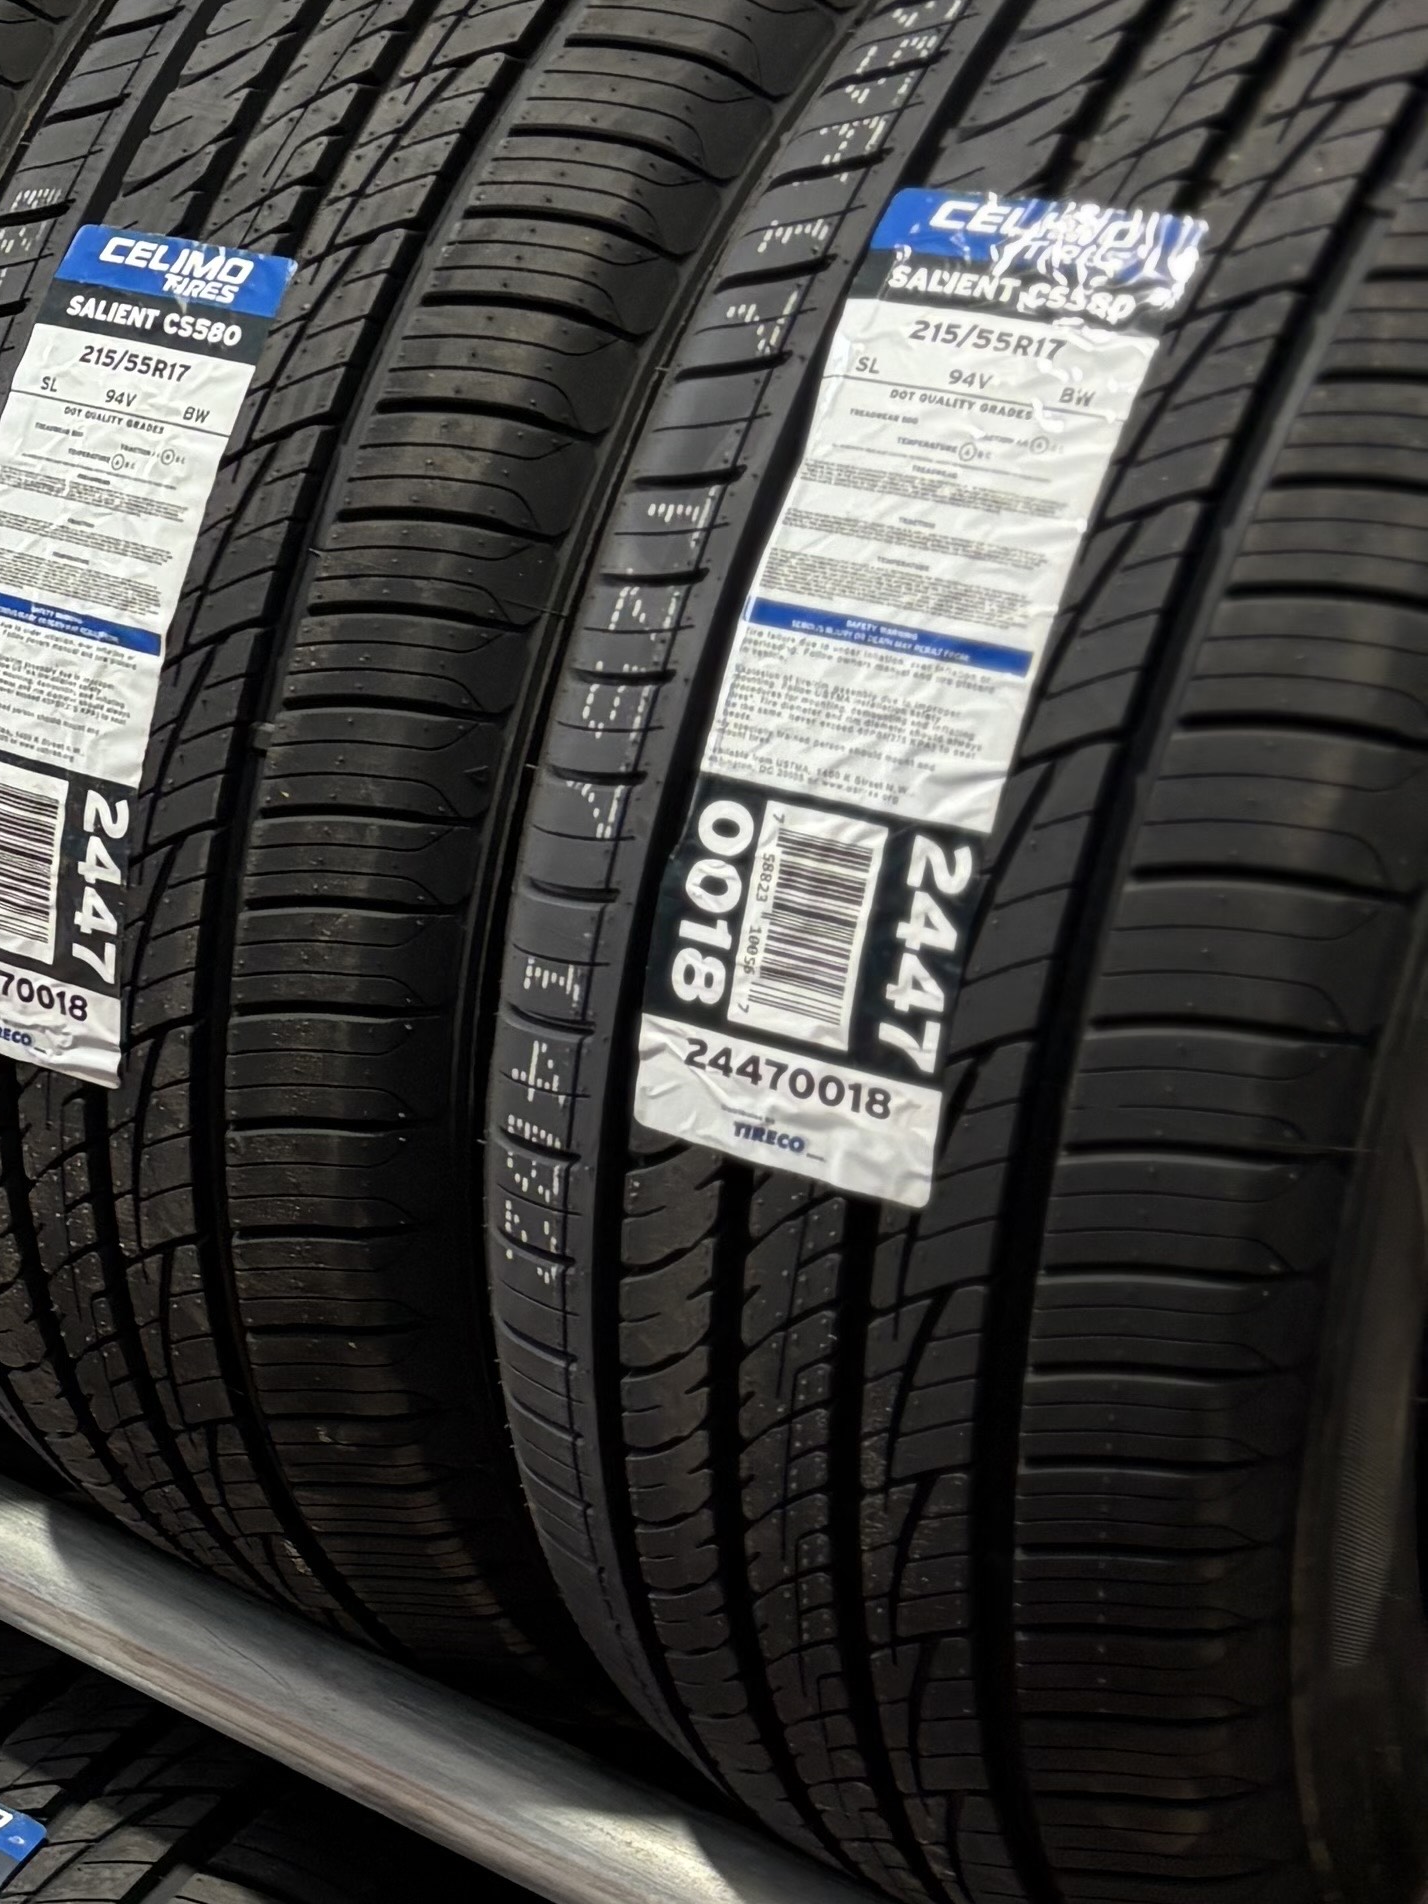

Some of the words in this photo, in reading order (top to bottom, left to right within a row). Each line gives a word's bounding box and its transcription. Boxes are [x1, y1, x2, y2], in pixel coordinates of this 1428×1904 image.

[99, 237, 254, 285] CELIMO
[163, 273, 239, 304] TIRES
[888, 265, 1022, 302] SALIENT
[1026, 283, 1137, 324] CS580
[66, 295, 160, 330] SALIENT
[163, 313, 242, 346] CS580
[909, 320, 1067, 361] 215/55R17
[79, 346, 191, 382] 215/55R17
[855, 356, 880, 375] SL
[948, 368, 995, 391] 94V
[1059, 387, 1096, 407] BW
[40, 376, 58, 393] SL
[104, 389, 137, 407] 94V
[183, 406, 210, 424] BW
[890, 389, 913, 403] DOT
[919, 392, 975, 412] QUALITY
[979, 403, 1033, 420] GRADES
[897, 436, 958, 454] TEMPERATURE
[774, 814, 785, 824] 7
[72, 789, 130, 985] 2447
[755, 852, 776, 903] 58823
[671, 799, 754, 1005] 0018
[743, 925, 763, 975] 10056
[879, 835, 973, 1074] 2447
[738, 1002, 749, 1013] 7
[684, 1038, 892, 1119] 24470018
[734, 1121, 805, 1153] TIRECO
